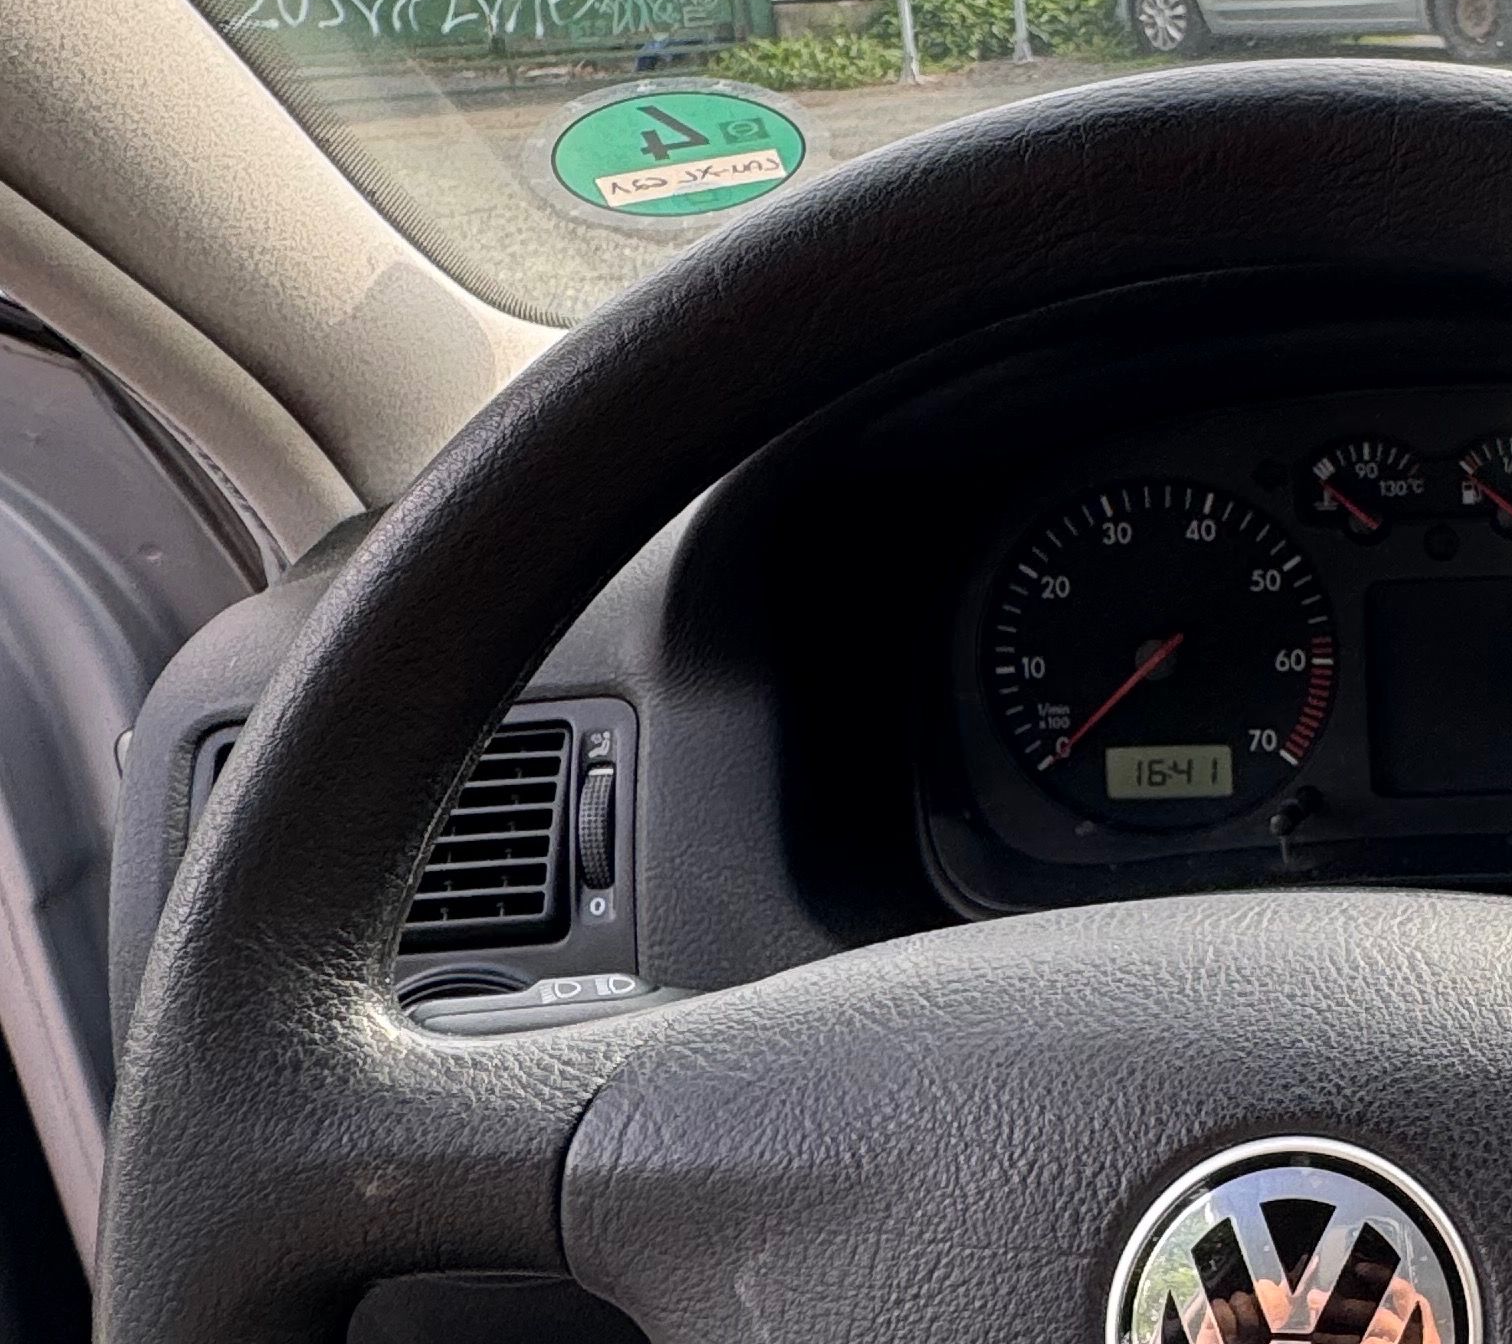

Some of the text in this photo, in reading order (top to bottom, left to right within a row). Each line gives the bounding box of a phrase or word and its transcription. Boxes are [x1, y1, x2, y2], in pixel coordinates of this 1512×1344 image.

[1355, 462, 1379, 479] 90
[1102, 522, 1132, 545] 30
[1184, 519, 1217, 542] 40
[1040, 575, 1070, 599] 20
[1250, 568, 1281, 592] 50
[1021, 656, 1046, 679] 10
[1274, 648, 1307, 672] 60
[1248, 728, 1278, 752] 70
